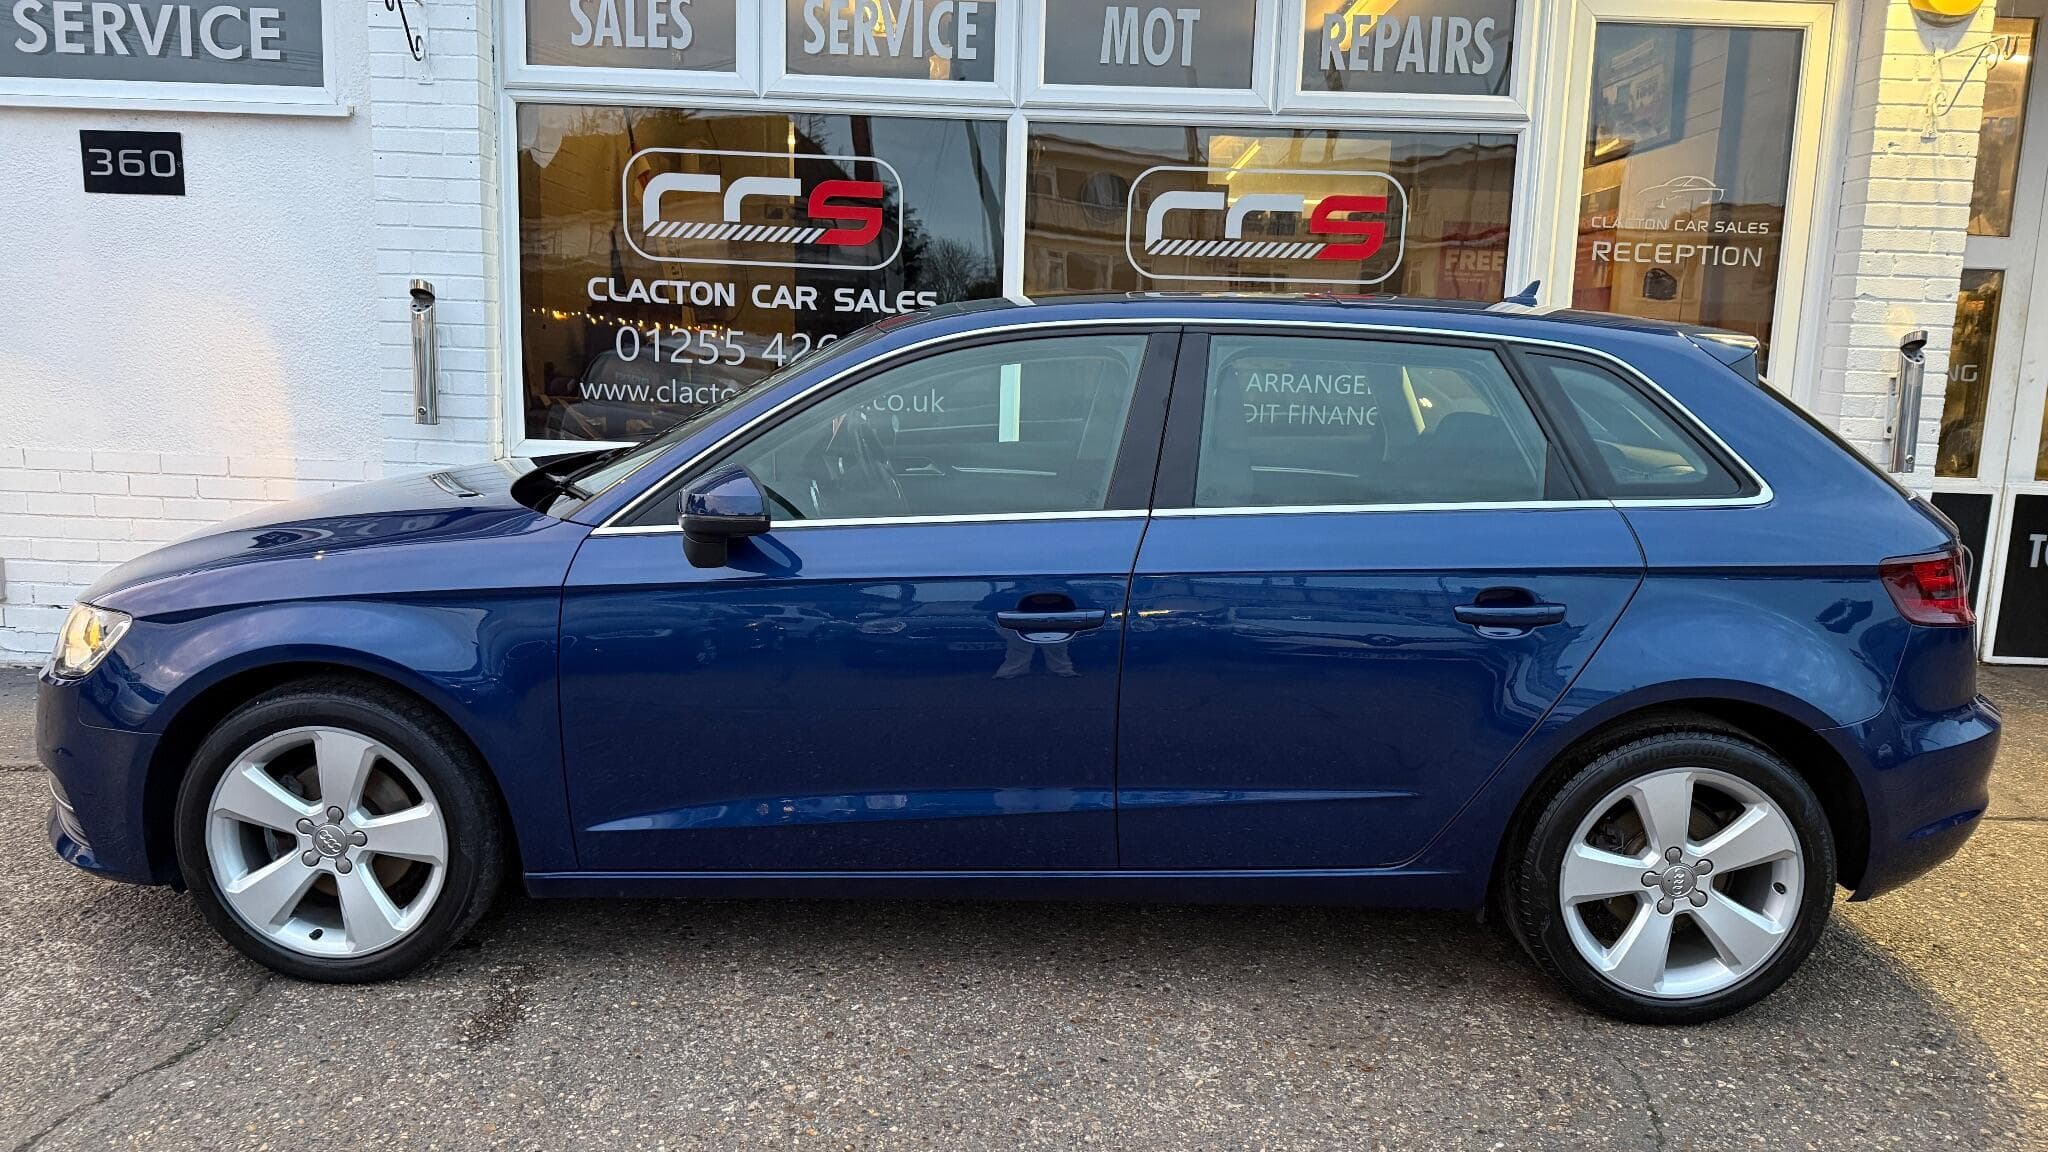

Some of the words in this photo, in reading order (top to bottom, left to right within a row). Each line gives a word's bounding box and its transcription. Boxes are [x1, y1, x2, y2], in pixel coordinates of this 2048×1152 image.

[12, 0, 281, 60] SERVICE
[571, 0, 693, 50] SALES
[803, 0, 978, 60] SERVICE
[1099, 6, 1201, 67] MOT
[1320, 13, 1496, 75] REPAIRS
[88, 148, 177, 178] 360
[1591, 216, 1669, 231] CLACTON
[1674, 219, 1709, 232] CAR
[1714, 221, 1770, 234] SALES
[1444, 249, 1505, 271] FREE
[1591, 240, 1763, 267] RECEPTION
[587, 277, 736, 307] CLACTON
[752, 284, 817, 311] CAR
[834, 288, 937, 313] SALES
[615, 326, 746, 366] 01255
[2029, 533, 2048, 568] T
